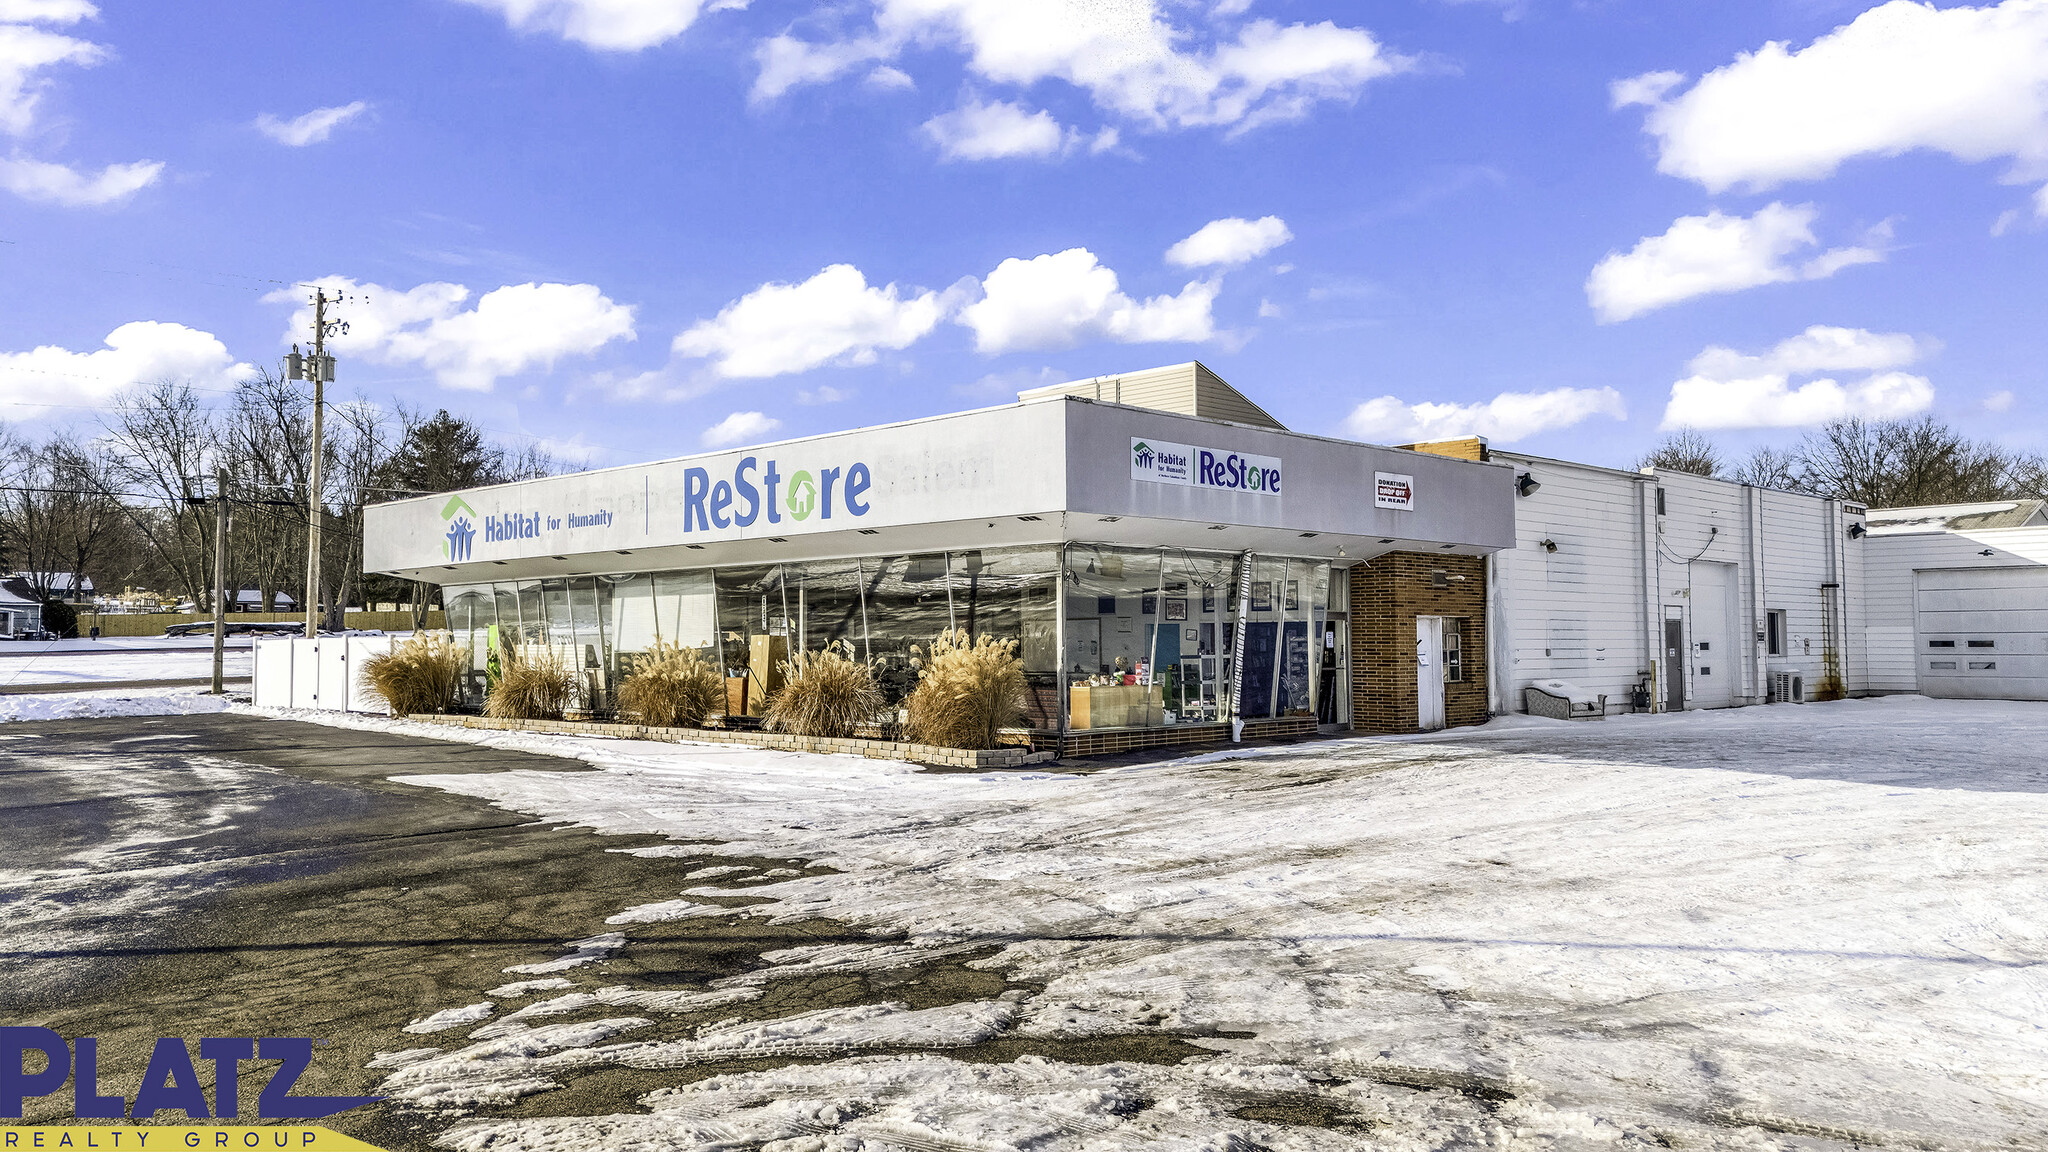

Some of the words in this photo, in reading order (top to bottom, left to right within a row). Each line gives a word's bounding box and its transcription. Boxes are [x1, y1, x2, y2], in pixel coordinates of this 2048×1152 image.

[1158, 452, 1186, 466] Habitat
[1200, 450, 1281, 493] ReStore
[1166, 466, 1187, 475] Humanity
[1378, 479, 1405, 487] DONATION
[683, 456, 871, 533] ReStore
[485, 511, 541, 542] Habitat
[547, 515, 561, 531] for
[568, 499, 613, 528] Humanity
